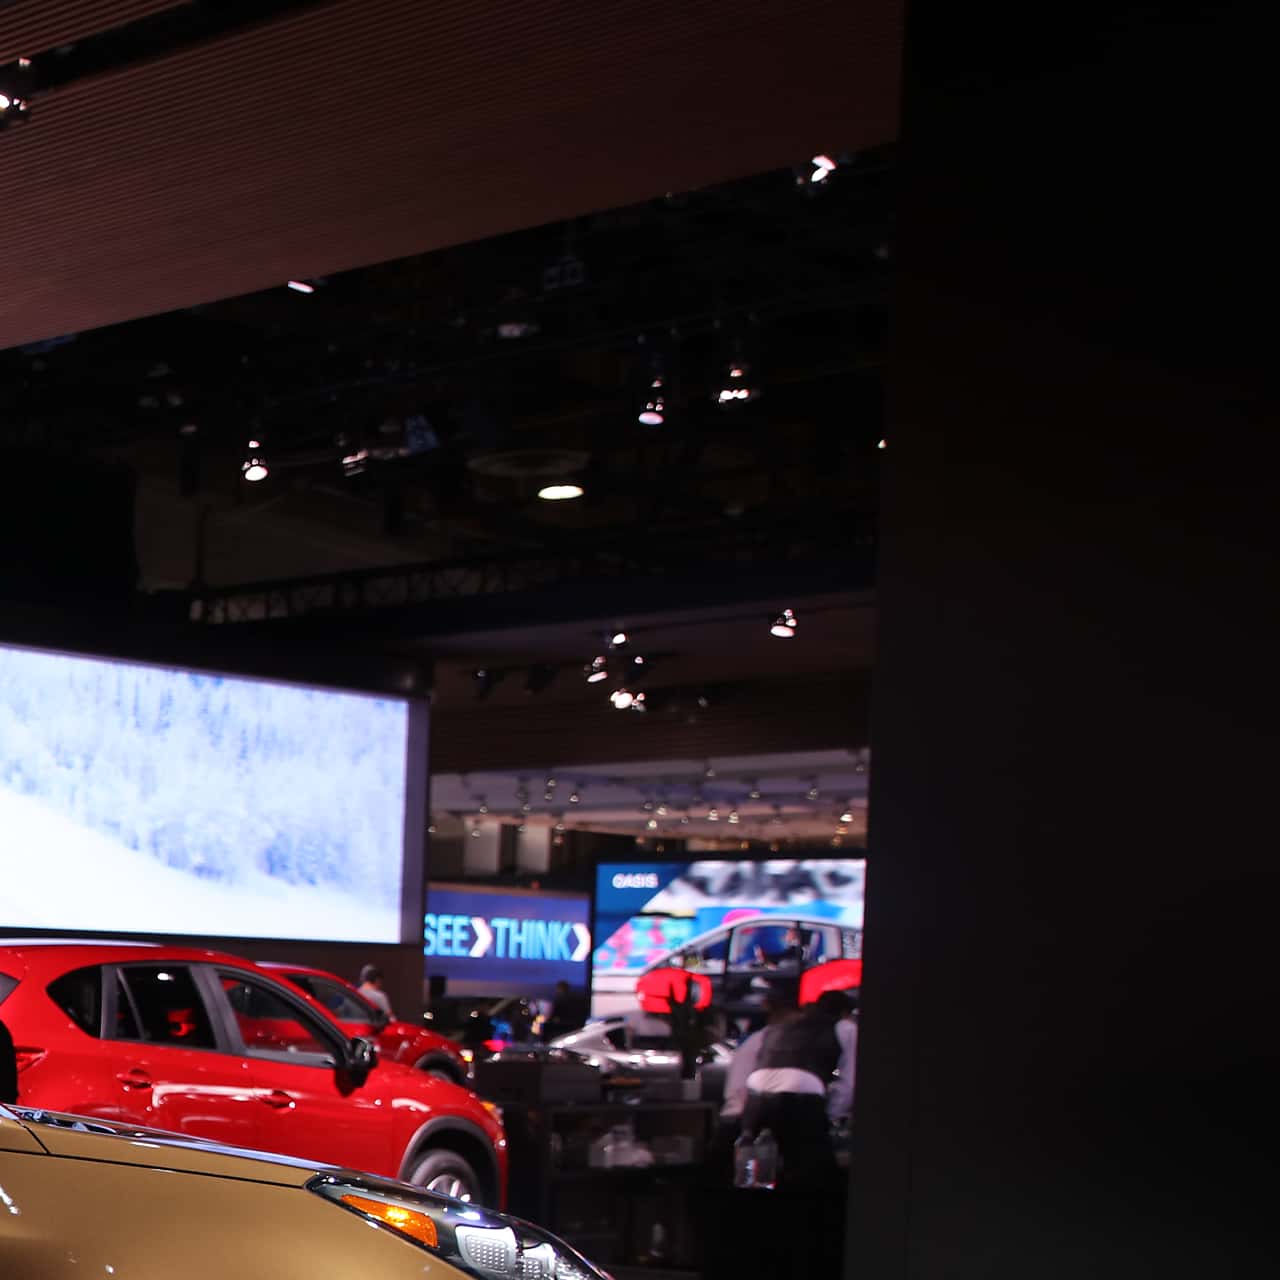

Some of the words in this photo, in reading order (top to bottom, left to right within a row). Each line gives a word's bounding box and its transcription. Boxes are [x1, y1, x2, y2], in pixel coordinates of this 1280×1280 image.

[612, 873, 658, 889] OASIS
[424, 914, 469, 957] SEE
[491, 917, 572, 961] THINK
